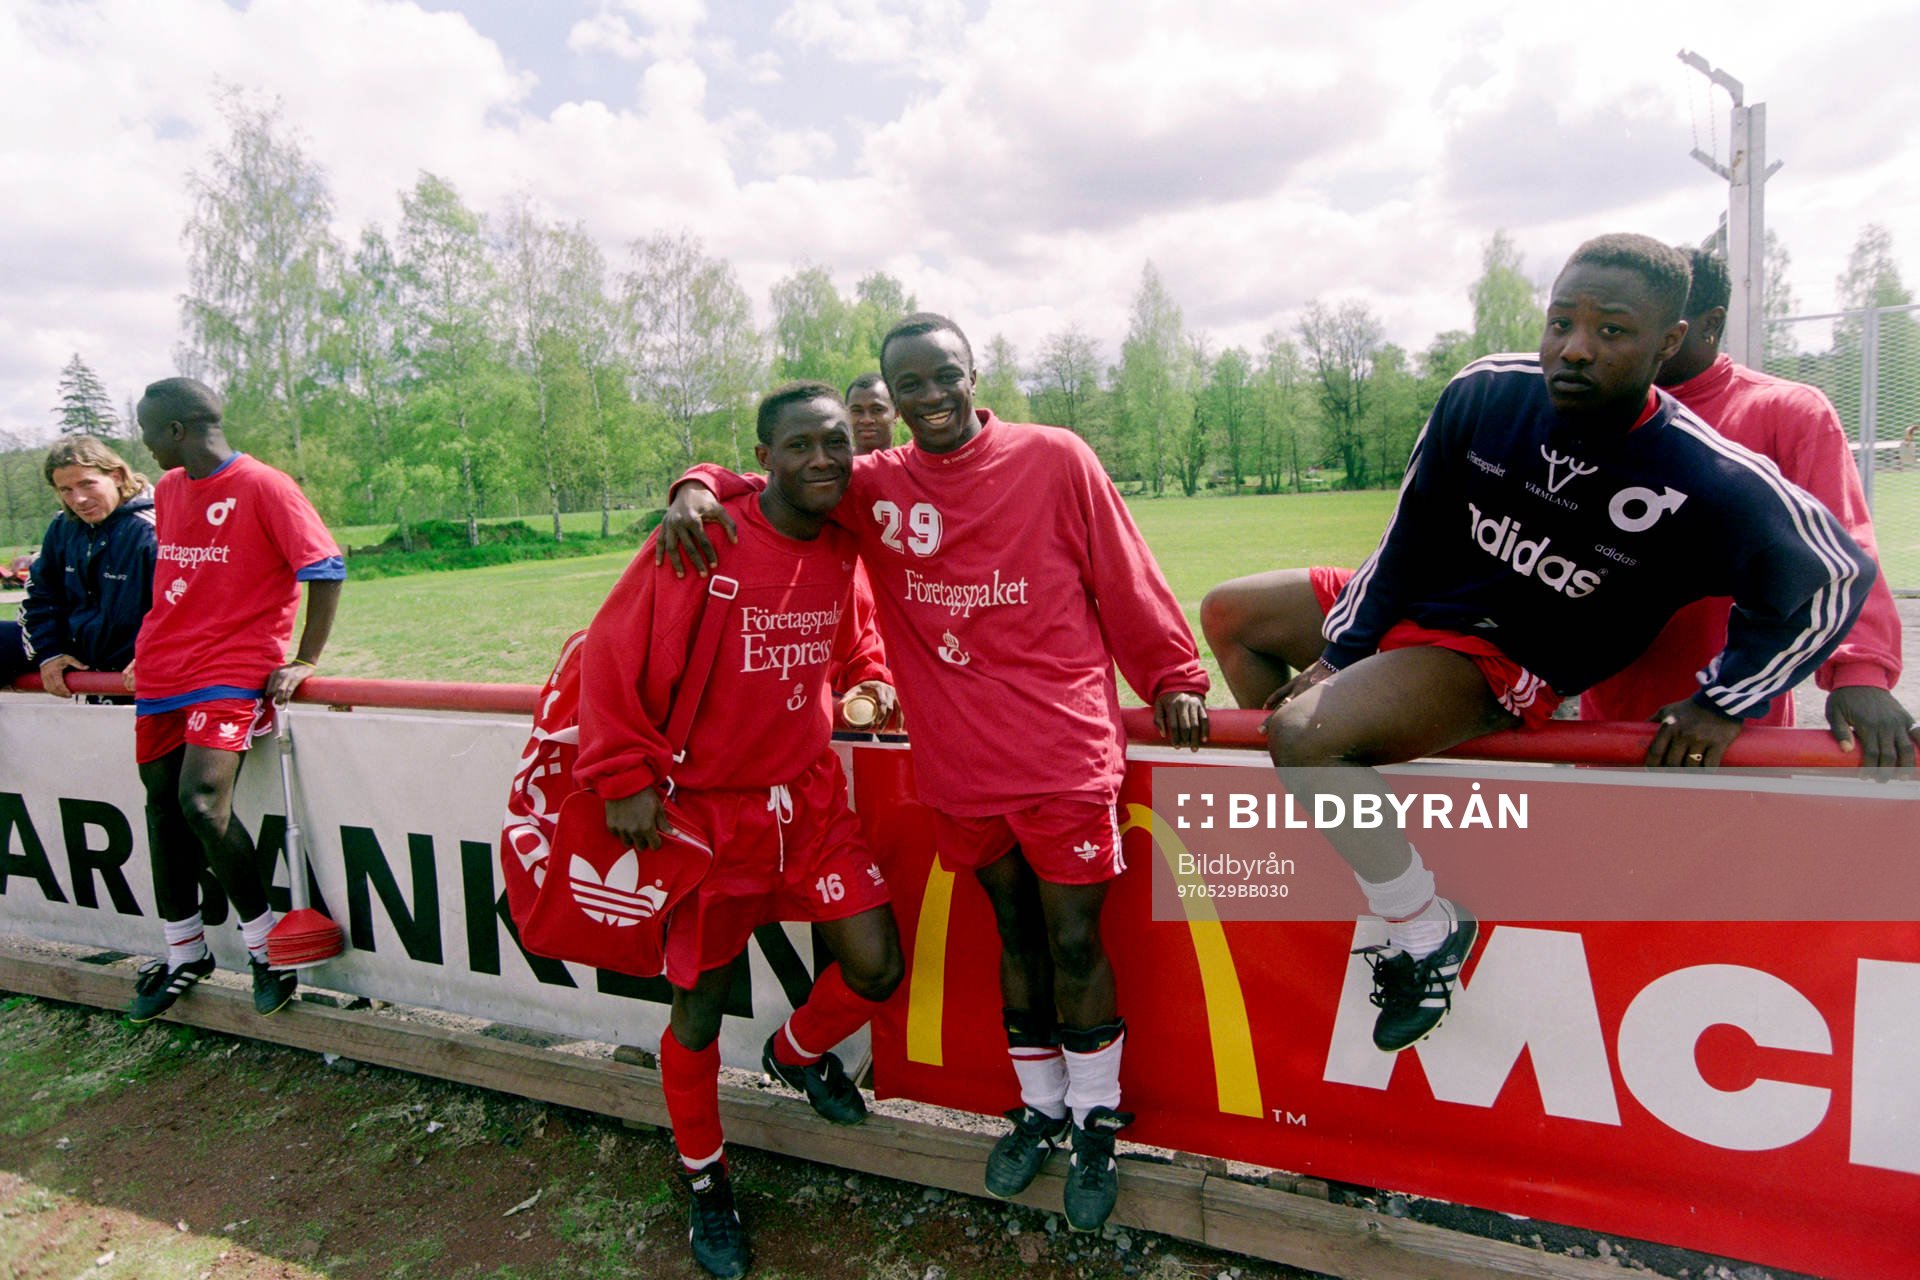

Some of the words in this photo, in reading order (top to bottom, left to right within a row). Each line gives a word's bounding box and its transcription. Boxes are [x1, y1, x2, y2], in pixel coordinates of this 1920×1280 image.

[1525, 481, 1578, 511] VÄRMLAND
[872, 500, 943, 557] 29
[1594, 543, 1638, 566] adidas
[904, 568, 1028, 618] Företagspaket
[740, 633, 832, 681] Express
[815, 872, 845, 904] 16
[1272, 1109, 1306, 1127] TM
